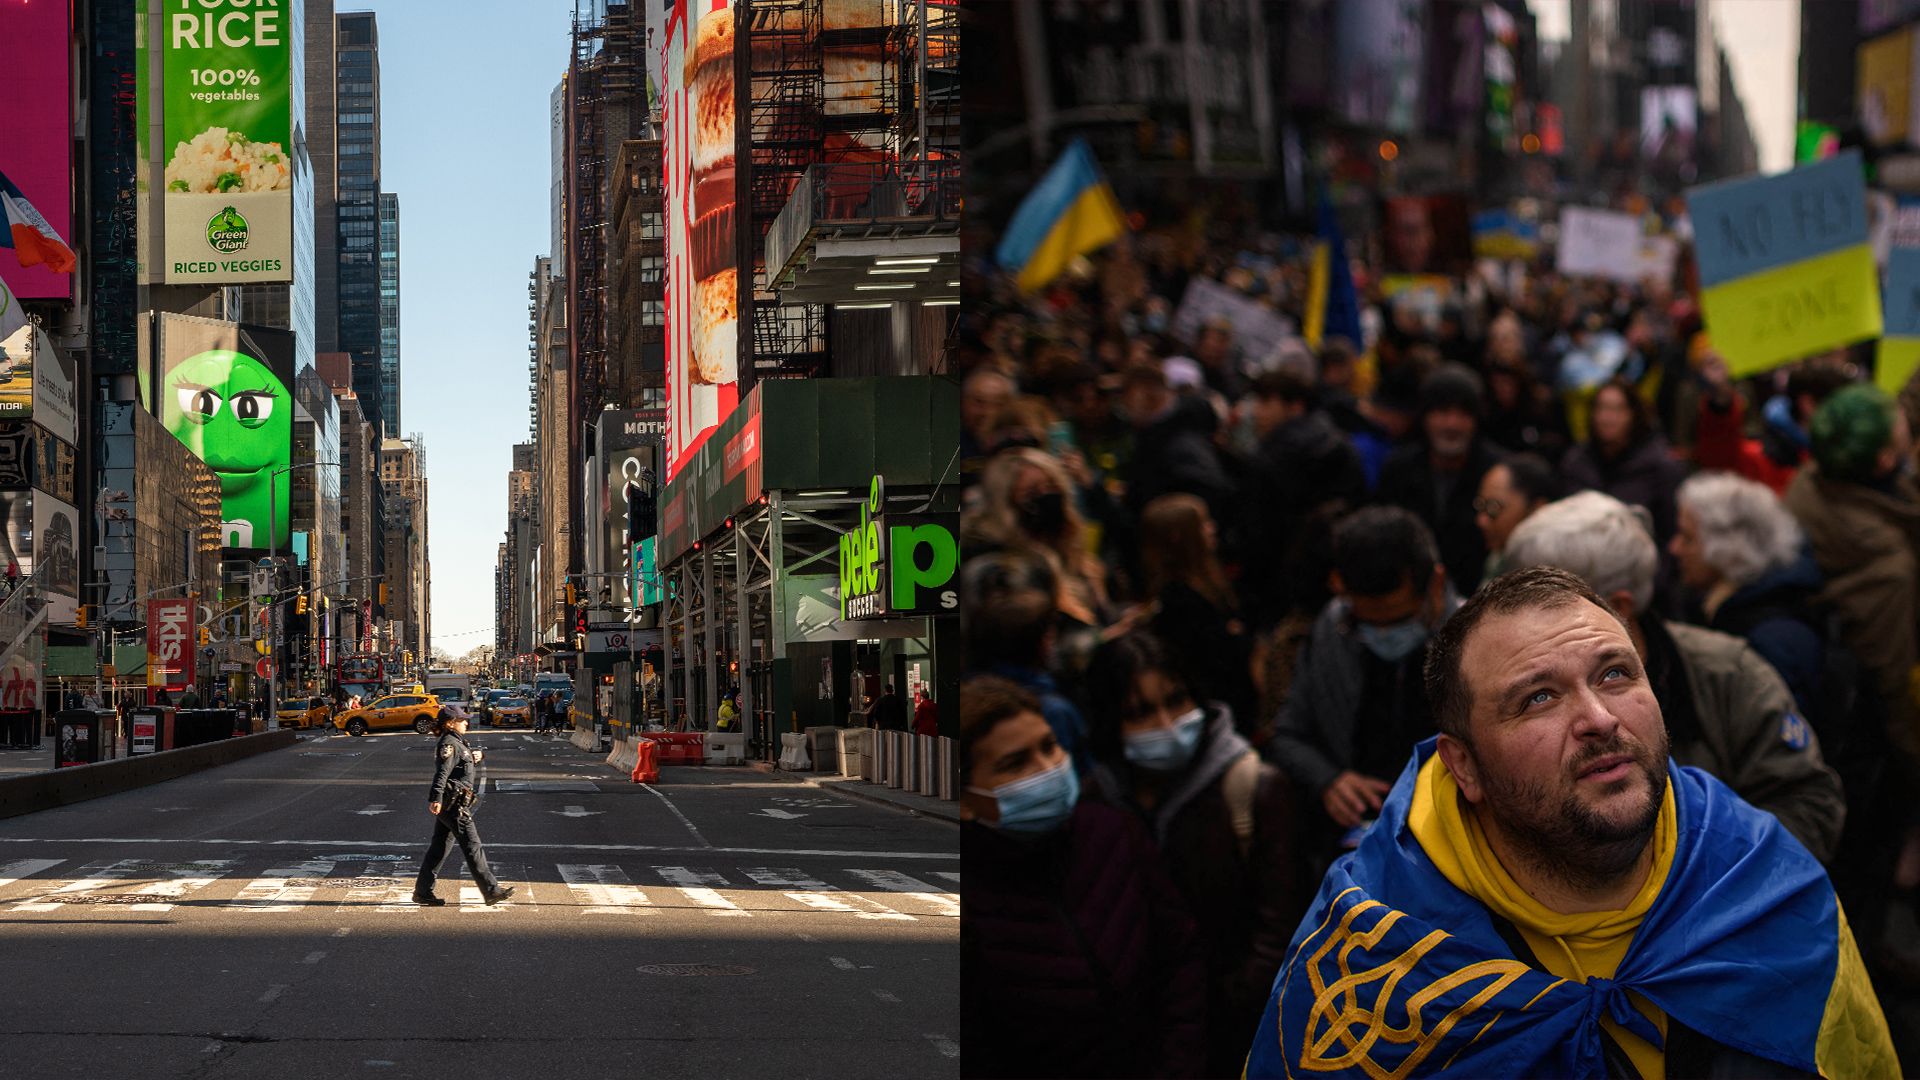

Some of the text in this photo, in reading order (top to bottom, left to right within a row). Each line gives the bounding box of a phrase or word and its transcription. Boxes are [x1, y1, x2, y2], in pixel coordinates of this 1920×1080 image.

[172, 10, 280, 49] RICE
[190, 68, 261, 86] 100%
[190, 88, 260, 103] vegetables
[211, 229, 248, 240] Green
[1718, 202, 1774, 260] NO
[215, 239, 249, 250] Giant
[174, 259, 282, 273] RICED VEGGIES
[624, 421, 666, 435] MOTH
[890, 523, 960, 610] p
[159, 604, 188, 661] tkts
